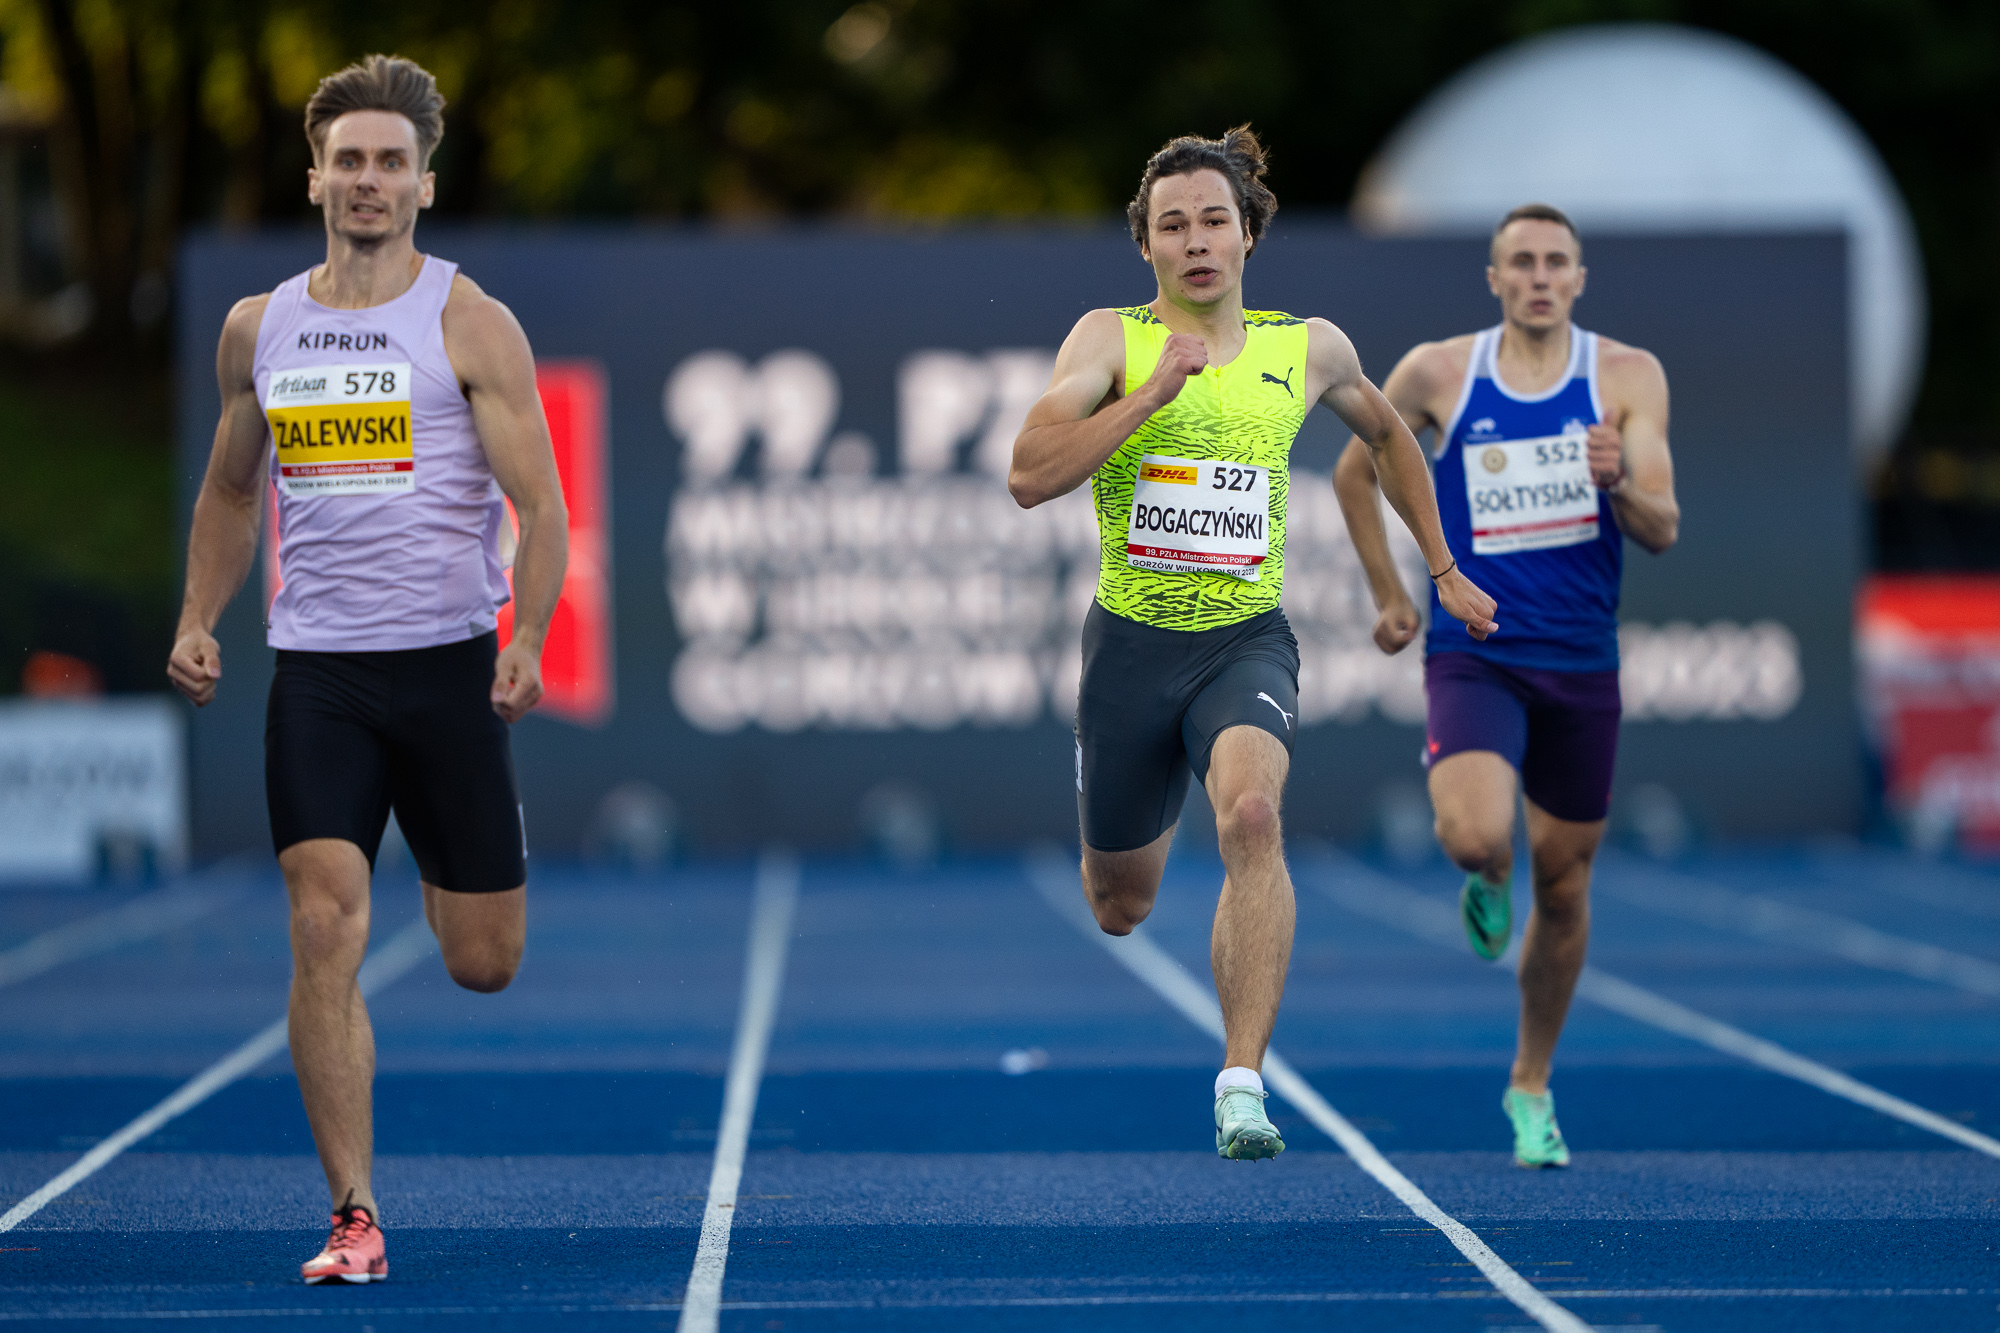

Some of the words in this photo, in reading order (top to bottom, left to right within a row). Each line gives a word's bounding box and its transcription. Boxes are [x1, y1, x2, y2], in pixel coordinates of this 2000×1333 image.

[297, 331, 388, 351] KIPRUN
[271, 374, 327, 397] Artisan
[344, 371, 396, 396] 578
[276, 416, 407, 449] ZALEWSKI
[1535, 440, 1580, 466] 552
[1147, 467, 1189, 480] DHL
[1212, 466, 1257, 492] 527
[1474, 477, 1590, 514] SOŁTYSIAK
[1134, 503, 1263, 540] BOGACZYŃSKI
[1132, 559, 1174, 570] GORZÓW
[1145, 547, 1158, 557] 99.
[1180, 552, 1228, 563] Mistrzostwa
[1229, 556, 1252, 564] Polski
